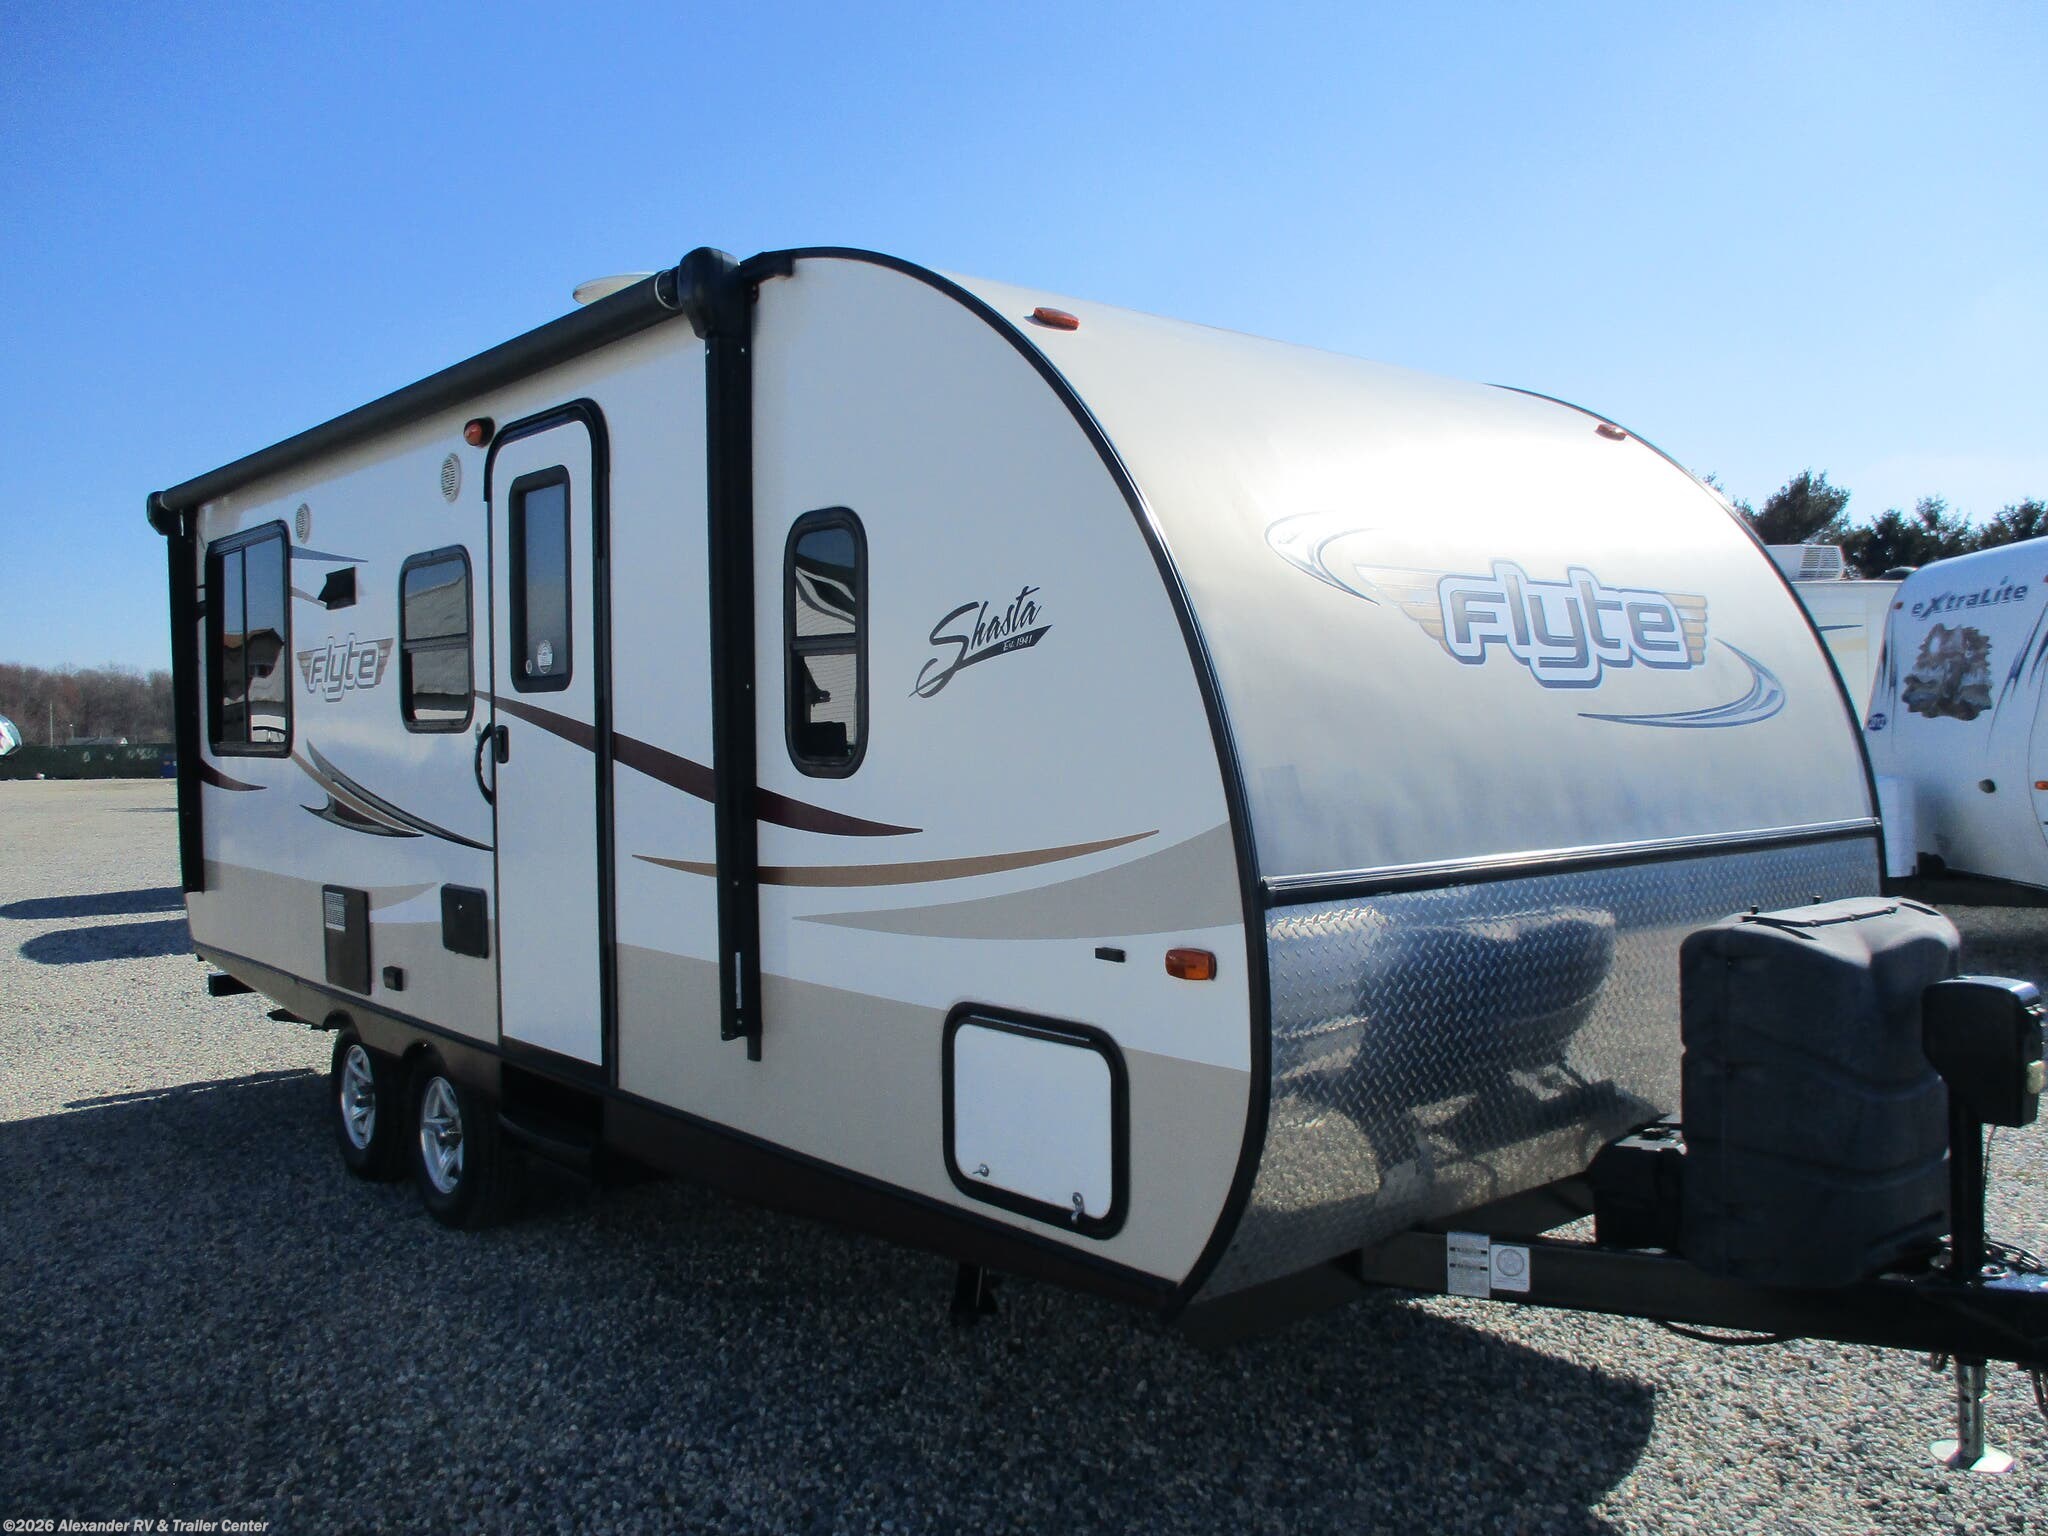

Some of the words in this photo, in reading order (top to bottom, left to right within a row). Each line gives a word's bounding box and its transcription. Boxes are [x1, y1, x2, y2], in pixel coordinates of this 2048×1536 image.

[308, 635, 379, 701] Flyte
[912, 585, 1043, 699] Shasta
[1016, 634, 1033, 647] 1941
[1440, 562, 1690, 686] Flyte
